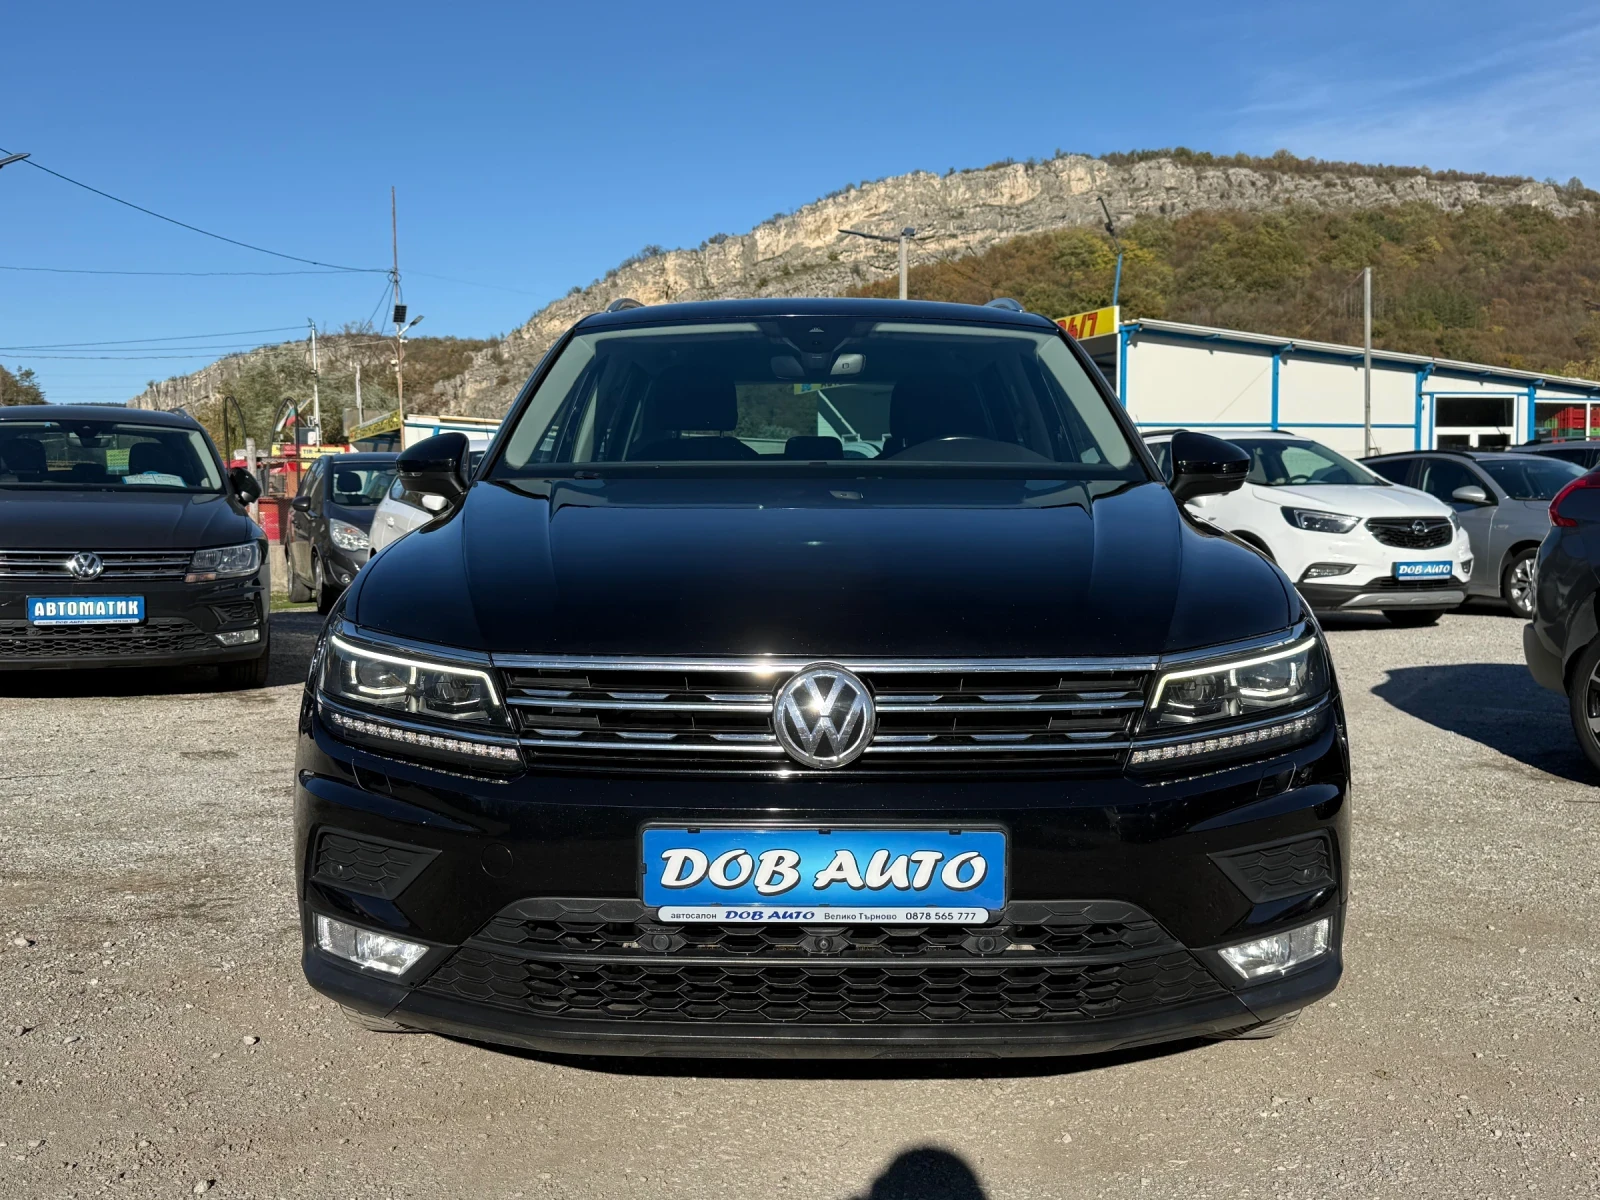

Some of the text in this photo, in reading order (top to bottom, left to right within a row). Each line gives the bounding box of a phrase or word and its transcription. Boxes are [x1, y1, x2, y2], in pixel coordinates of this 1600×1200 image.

[1399, 564, 1451, 574] DOB AUTO
[34, 601, 138, 616] АВТОМАТИК
[774, 661, 875, 768] VW
[660, 848, 988, 894] DOB AUTO
[725, 910, 764, 920] DOB
[767, 910, 815, 920] AUTO
[824, 912, 856, 920] Велико
[858, 912, 897, 921] Търново
[905, 911, 931, 920] 0878
[934, 911, 954, 920] 565
[957, 911, 977, 920] 777
